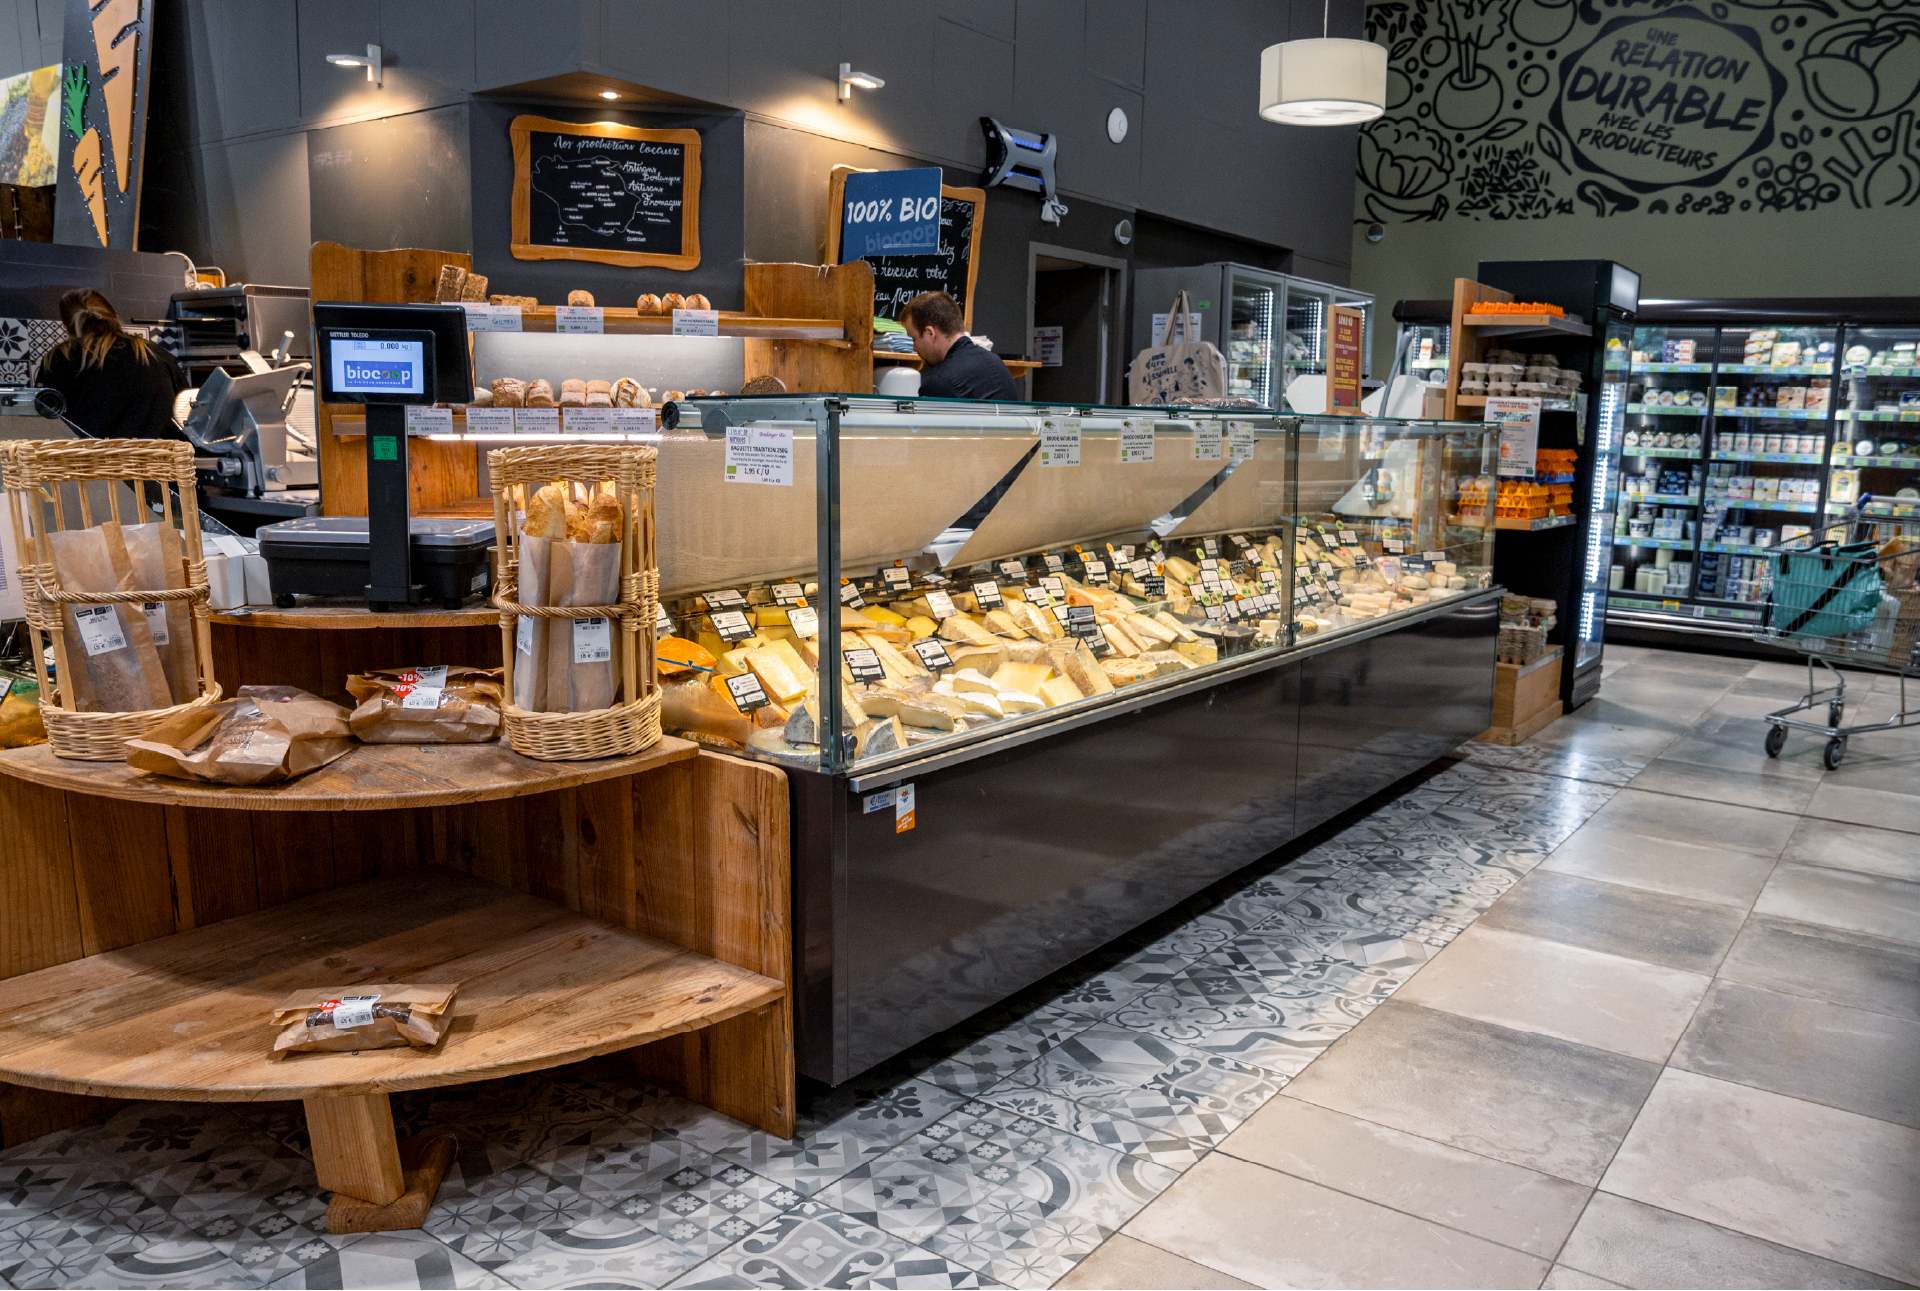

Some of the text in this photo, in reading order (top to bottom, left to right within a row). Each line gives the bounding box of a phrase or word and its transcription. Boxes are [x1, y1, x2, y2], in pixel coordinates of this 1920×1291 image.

[1647, 28, 1678, 46] UNE
[1610, 39, 1750, 84] RELATION
[1567, 66, 1766, 131] DURABLE
[1596, 112, 1674, 140] AVEC LES
[554, 135, 680, 156] Nos producteurs locaux
[1577, 128, 1718, 172] PRODUCTEURS
[622, 160, 657, 174] Artisans
[628, 182, 664, 194] Artisans
[847, 196, 938, 224] 100% BIO
[864, 224, 936, 253] biocoop
[881, 260, 919, 278] réserver
[926, 264, 948, 280] votre
[1338, 314, 1354, 326] INFO
[346, 364, 410, 385] biocoop
[759, 431, 778, 439] Boulanger
